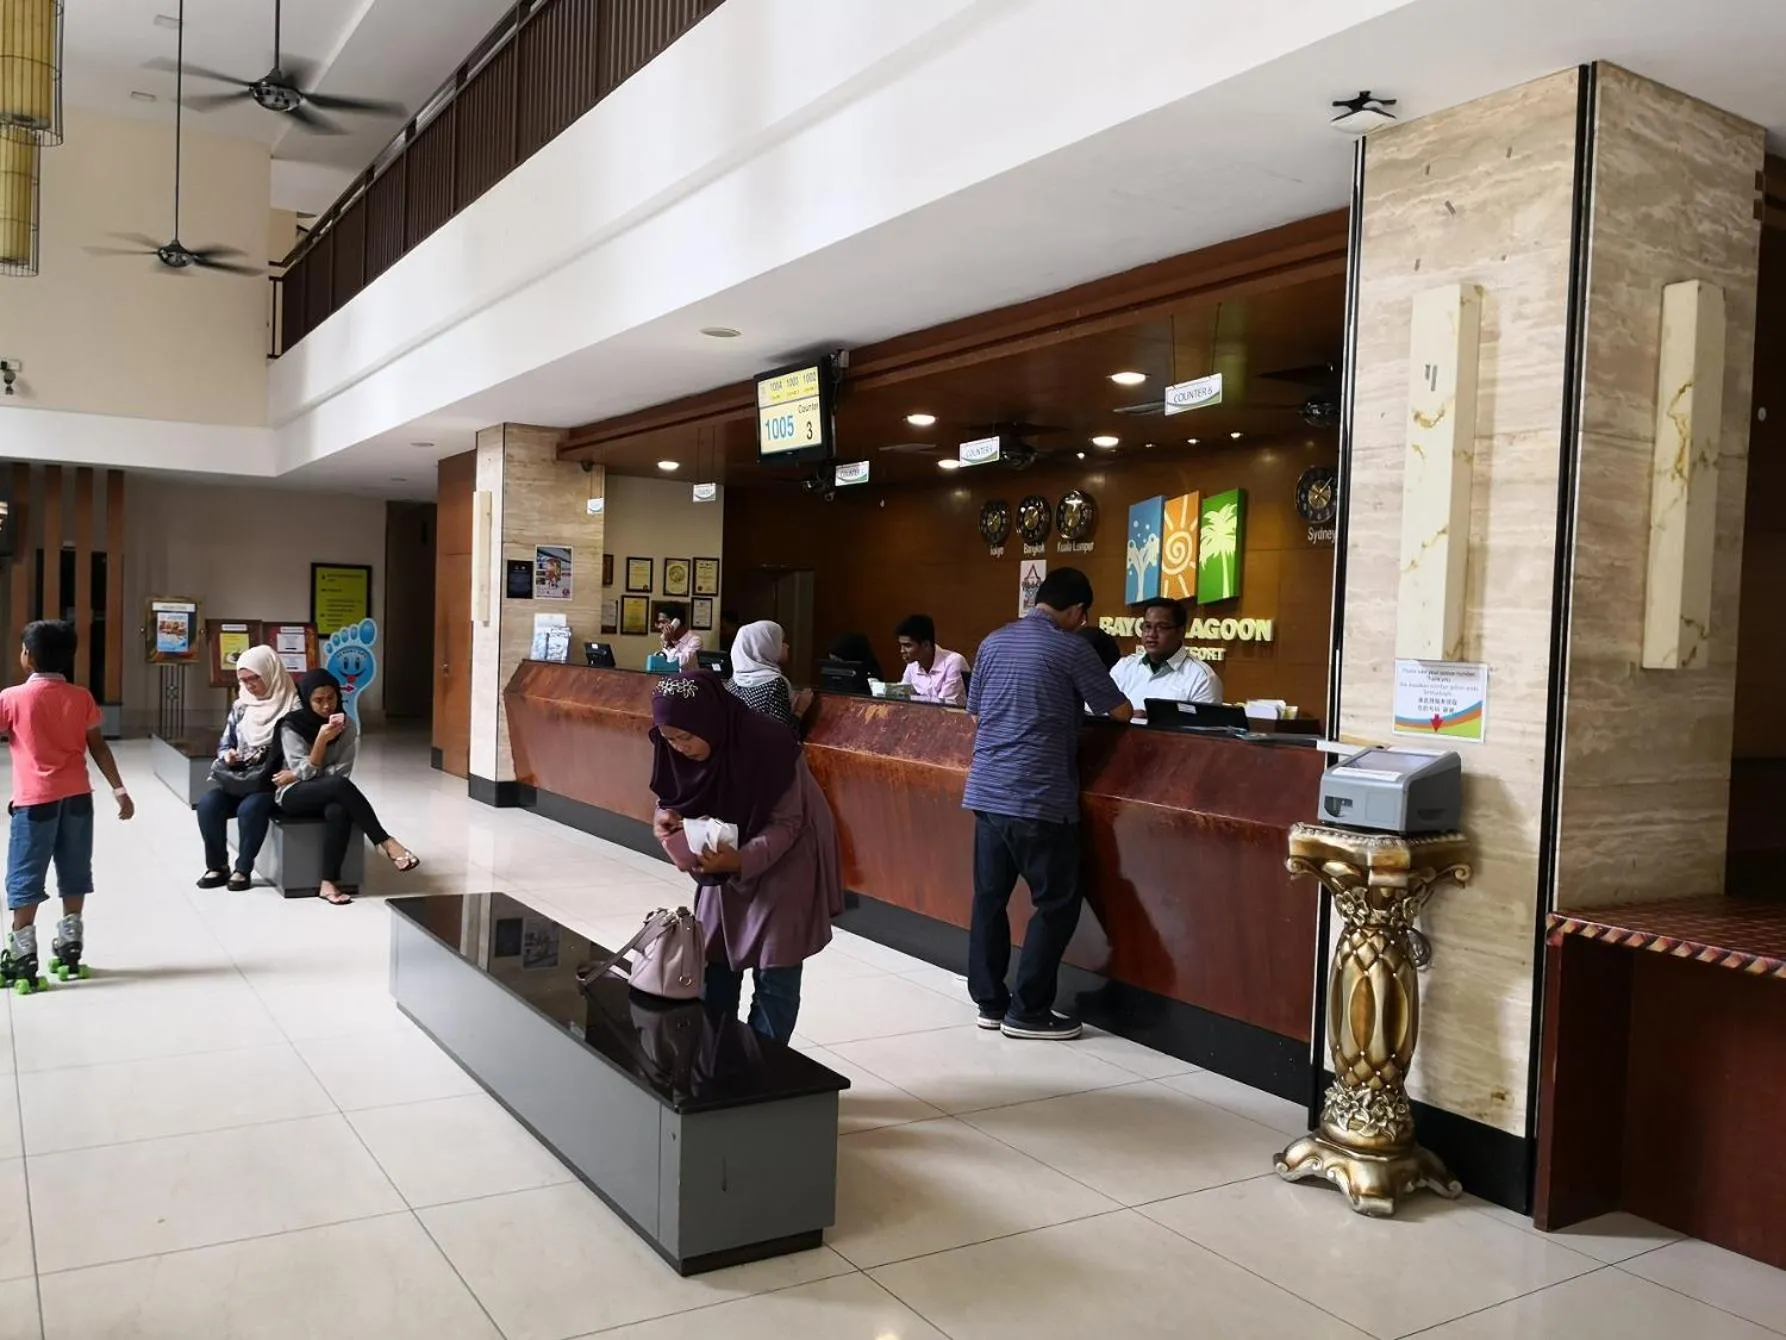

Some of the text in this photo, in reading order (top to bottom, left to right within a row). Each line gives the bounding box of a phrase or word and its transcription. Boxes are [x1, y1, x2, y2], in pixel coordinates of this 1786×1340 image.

[1174, 388, 1207, 403] COUNTER
[765, 415, 813, 440] 1005 3
[1308, 526, 1336, 544] Sydney
